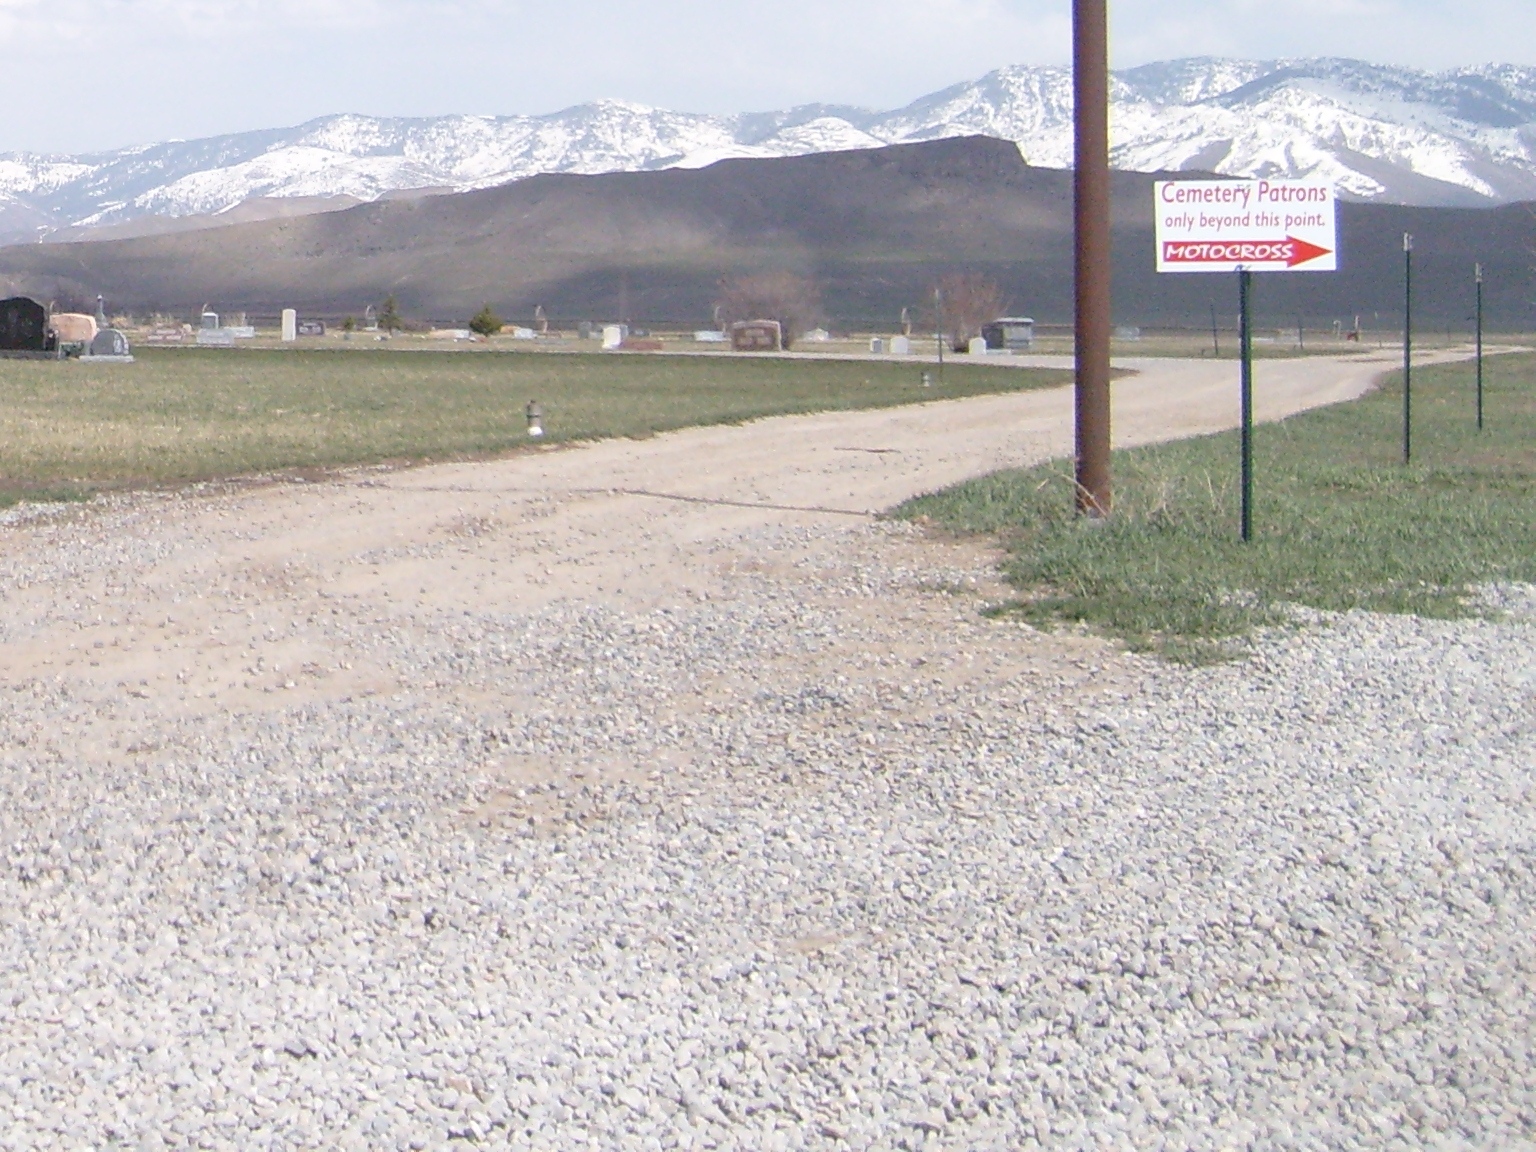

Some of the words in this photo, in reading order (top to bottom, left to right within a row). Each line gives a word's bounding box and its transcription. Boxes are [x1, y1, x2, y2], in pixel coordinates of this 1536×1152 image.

[1162, 181, 1251, 209] Cemetery
[1257, 180, 1327, 202] Patrons
[1165, 212, 1195, 232] only
[1199, 211, 1250, 232] beyond
[1255, 211, 1280, 227] this
[1285, 212, 1326, 231] point.
[1165, 243, 1294, 260] MOTOCROSS
